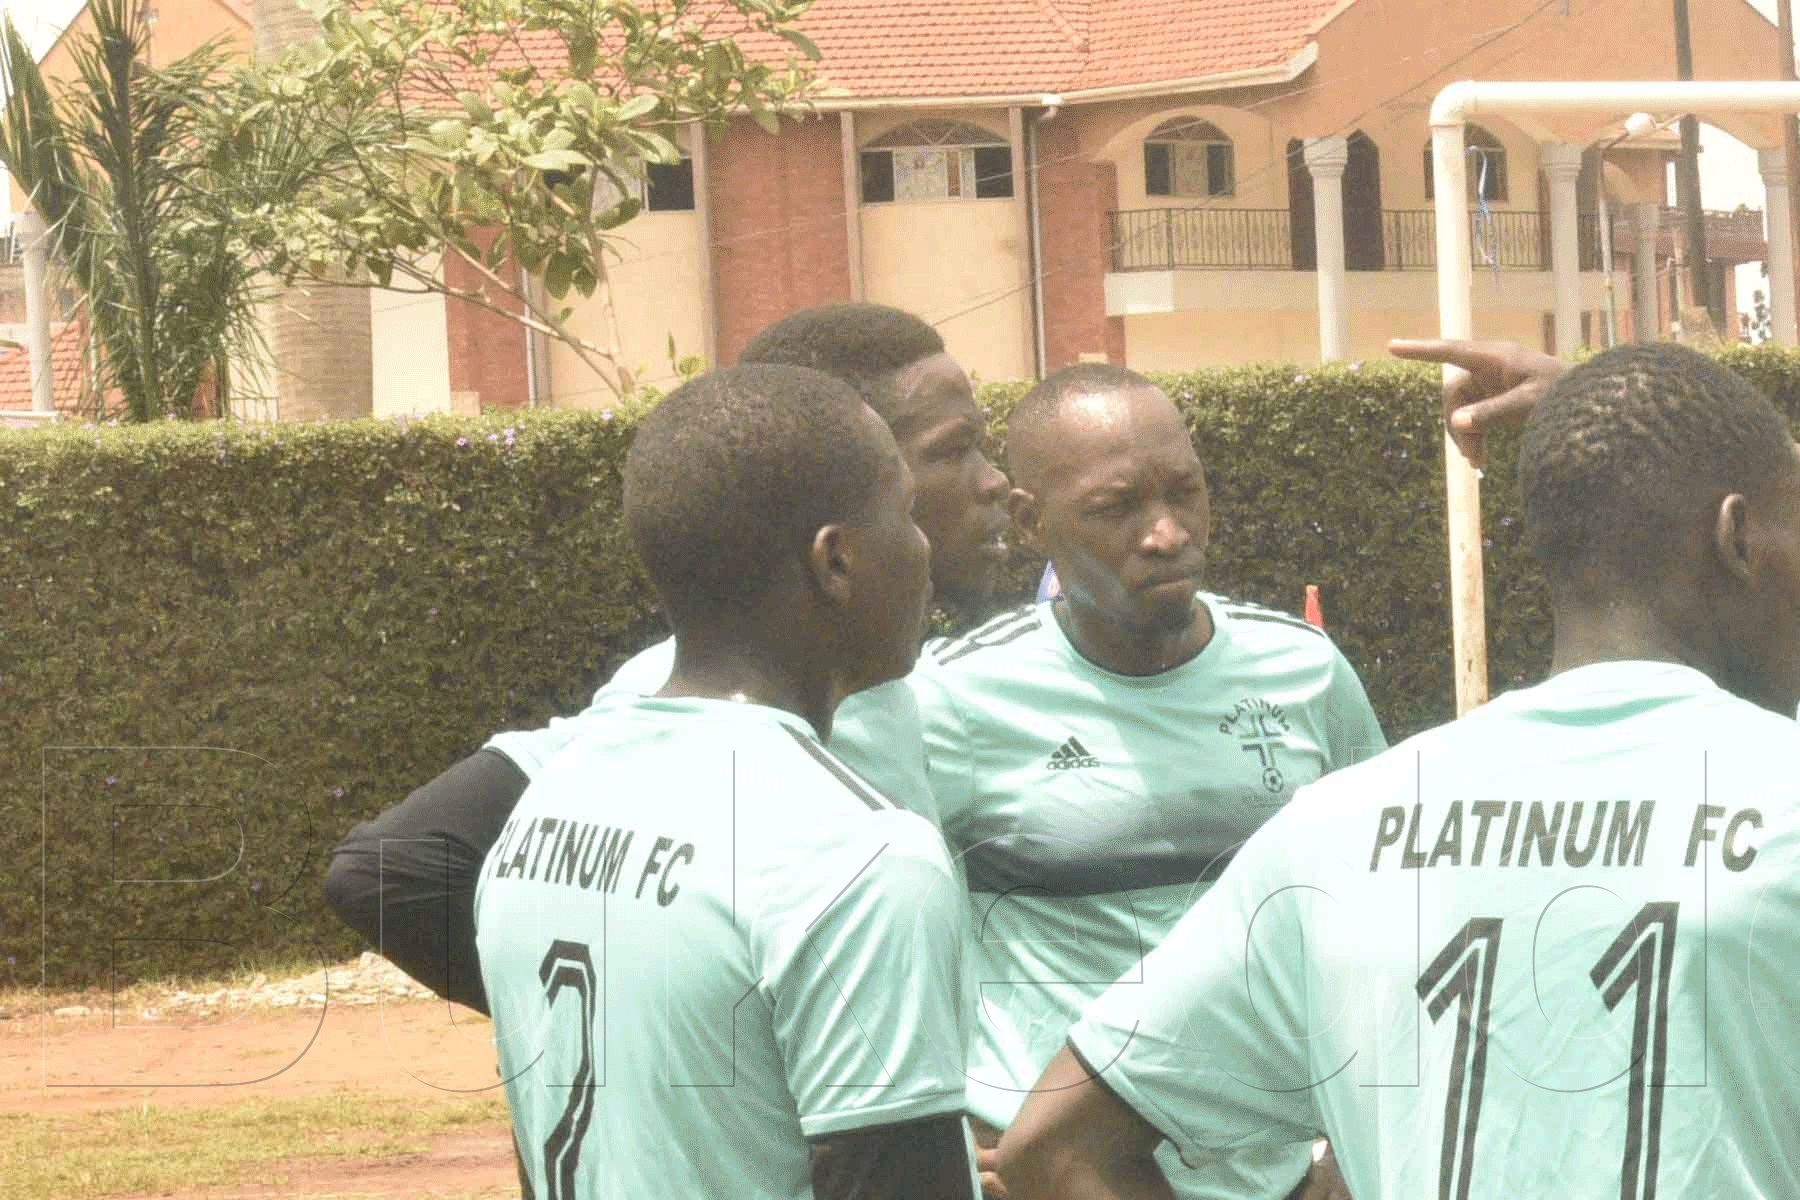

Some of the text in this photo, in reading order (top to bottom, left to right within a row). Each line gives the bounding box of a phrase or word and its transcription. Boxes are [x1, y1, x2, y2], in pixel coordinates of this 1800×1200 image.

[1046, 757, 1100, 770] adidas
[634, 835, 696, 909] FC
[1369, 800, 1765, 873] PLATINUM FC
